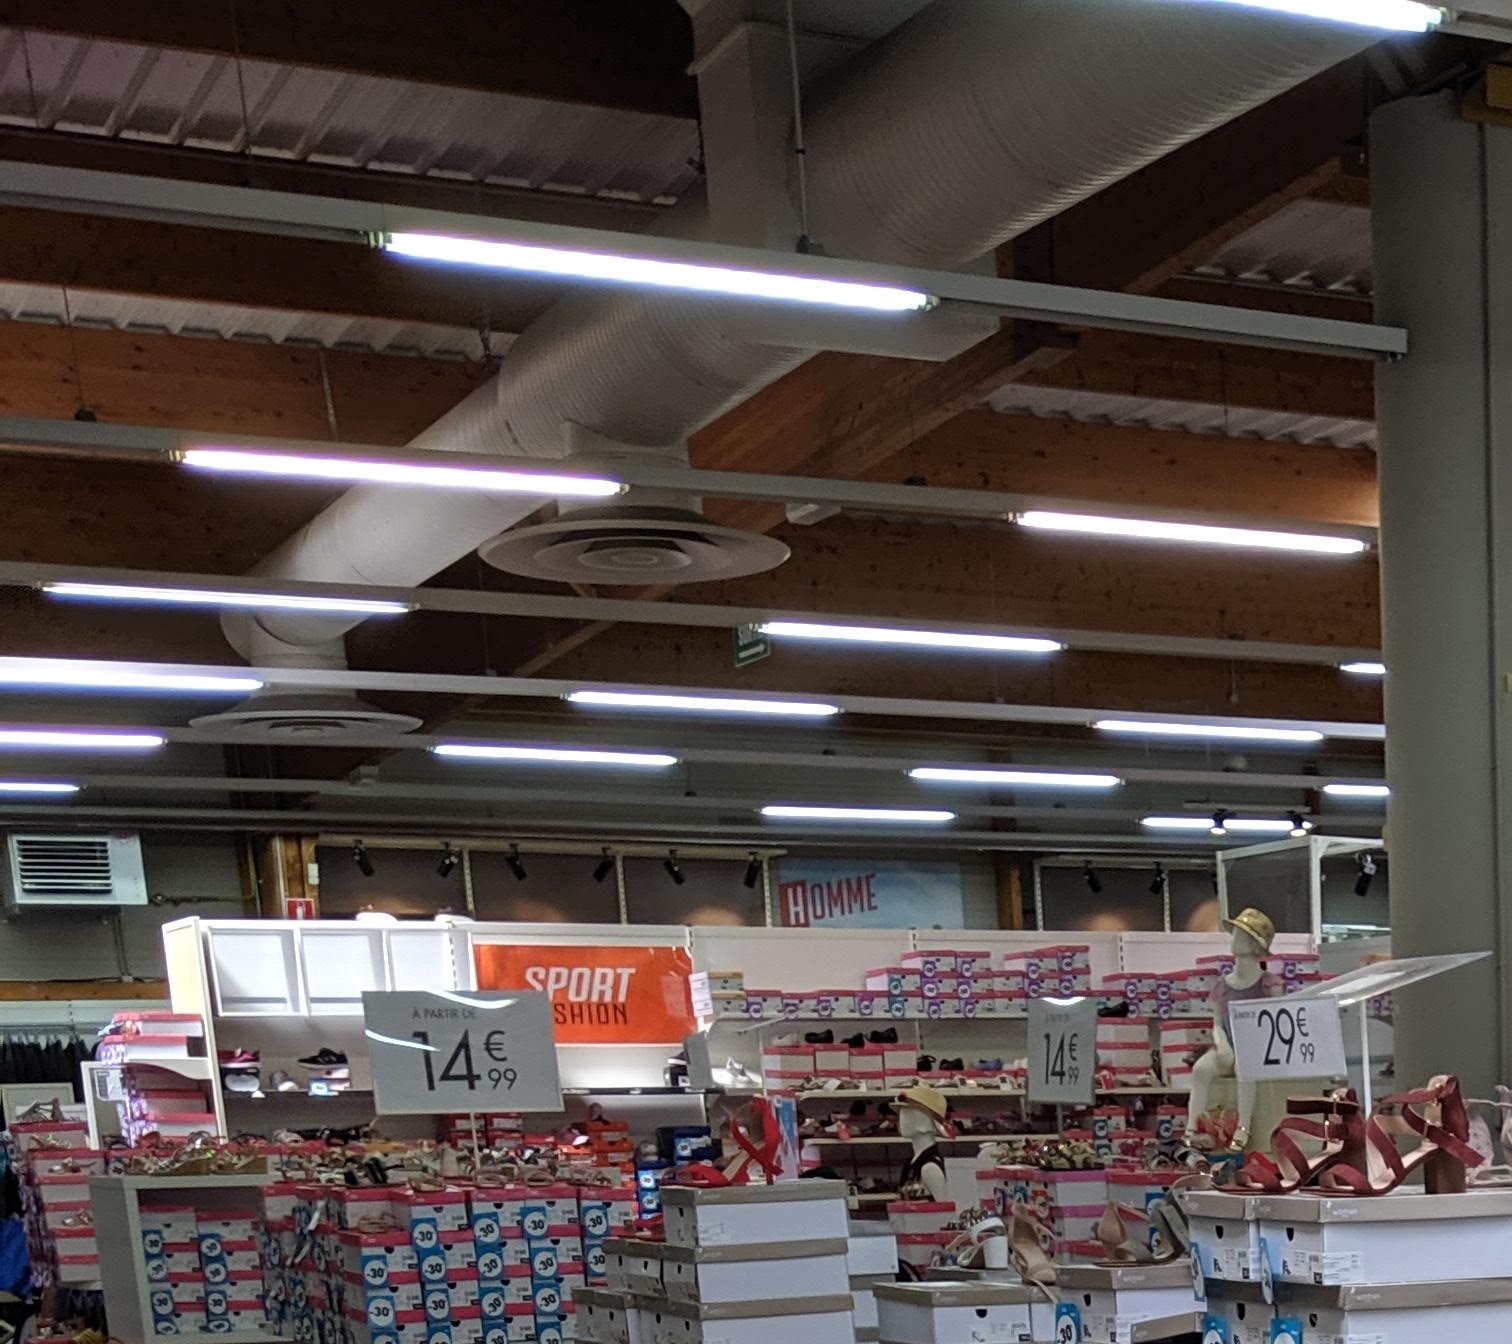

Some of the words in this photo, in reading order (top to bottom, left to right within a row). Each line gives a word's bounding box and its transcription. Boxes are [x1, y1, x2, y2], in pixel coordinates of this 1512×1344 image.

[788, 873, 878, 925] HOMME
[525, 967, 636, 1003] SPORT
[413, 1028, 482, 1091] 14
[1257, 1008, 1295, 1065] 29
